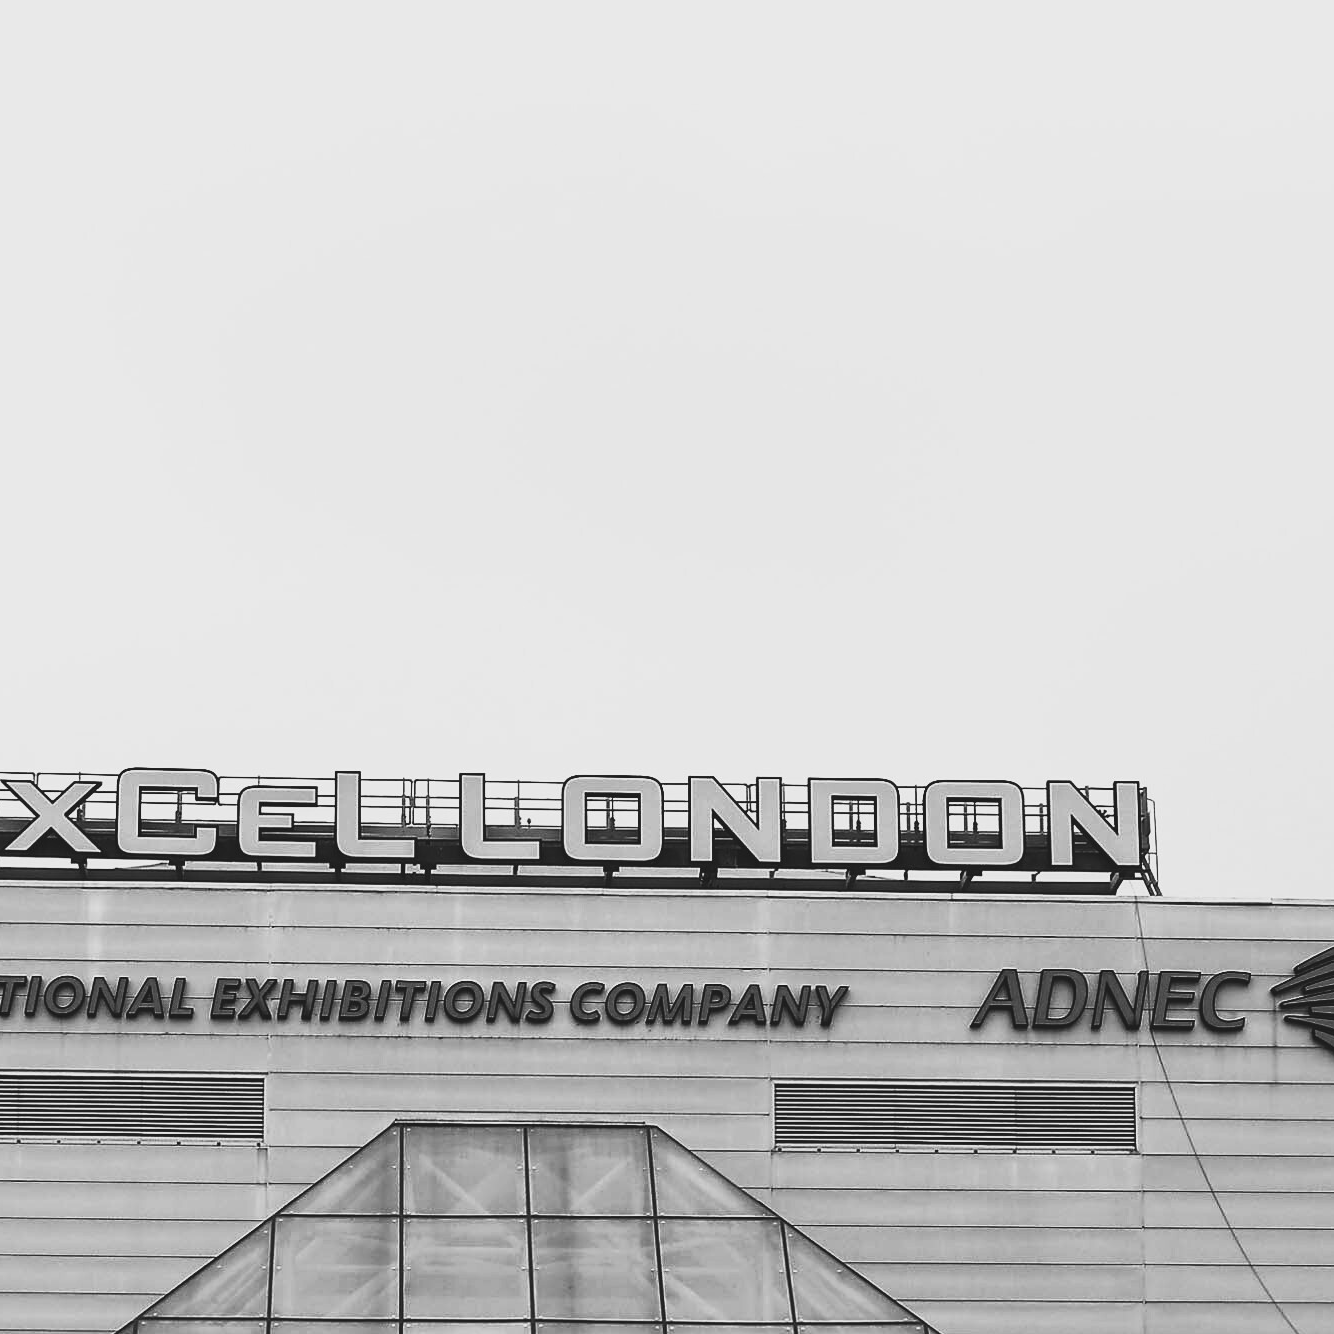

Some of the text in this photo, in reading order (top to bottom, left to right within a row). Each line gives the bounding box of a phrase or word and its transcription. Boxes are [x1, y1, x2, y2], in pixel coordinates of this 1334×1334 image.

[459, 772, 1142, 868] LONDON
[210, 978, 556, 1023] EXHIBITIONS
[569, 981, 850, 1027] COMPANY
[969, 968, 1252, 1032] ADNEC
